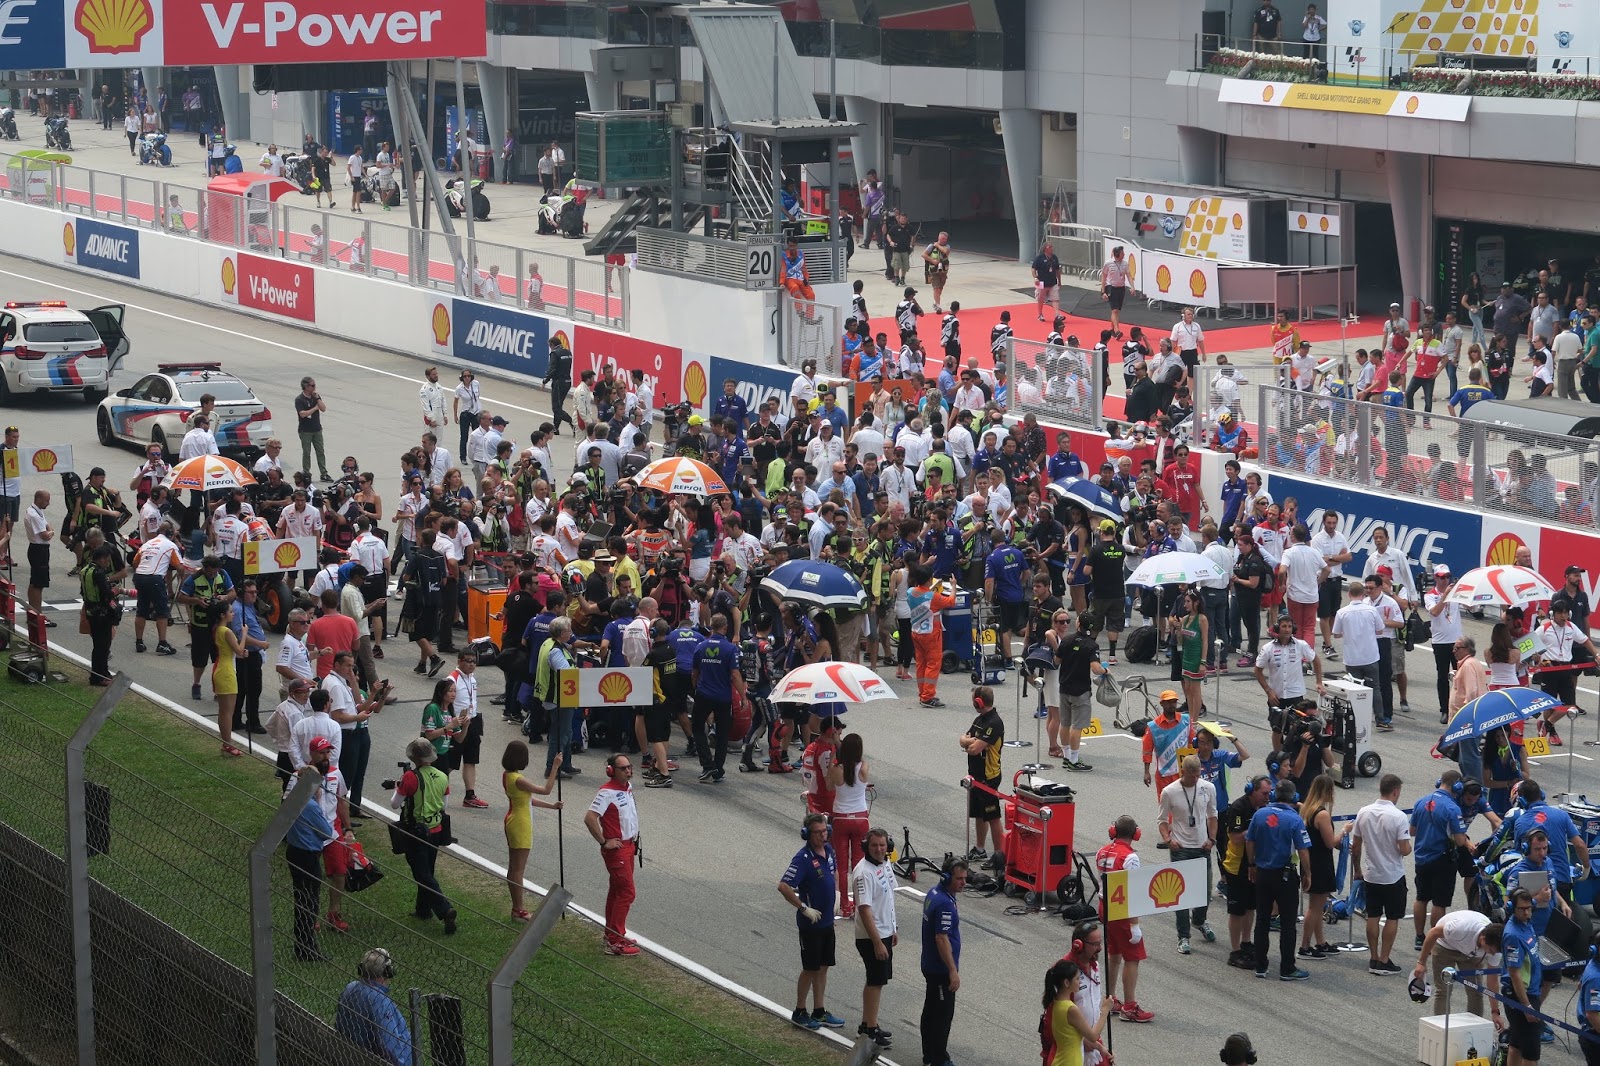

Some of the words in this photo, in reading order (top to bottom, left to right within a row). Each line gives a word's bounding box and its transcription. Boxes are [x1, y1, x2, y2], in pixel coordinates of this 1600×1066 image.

[202, 2, 442, 49] V-Power
[1296, 91, 1309, 100] SHELL
[1309, 92, 1329, 102] MALAYSIA
[1330, 94, 1356, 104] MOTORCYCLE
[1356, 96, 1372, 105] GRAND
[1371, 97, 1382, 105] PRIX
[85, 233, 130, 263] ADVANCE
[749, 250, 772, 275] 20
[249, 274, 298, 309] V-Power
[754, 280, 766, 288] LAP
[465, 319, 535, 359] ADVANCE
[7, 457, 15, 469] 1
[206, 479, 235, 487] REPSOL
[673, 484, 703, 492] REPSOL
[777, 507, 787, 515] 46
[246, 551, 257, 565] 2
[1518, 638, 1535, 653] 29
[563, 680, 577, 696] 3
[1521, 699, 1554, 715] SUZUKI
[1479, 712, 1519, 731] ECSTAR
[1444, 727, 1473, 743] SUZUKI
[1529, 739, 1545, 754] 29
[1110, 884, 1126, 905] 4
